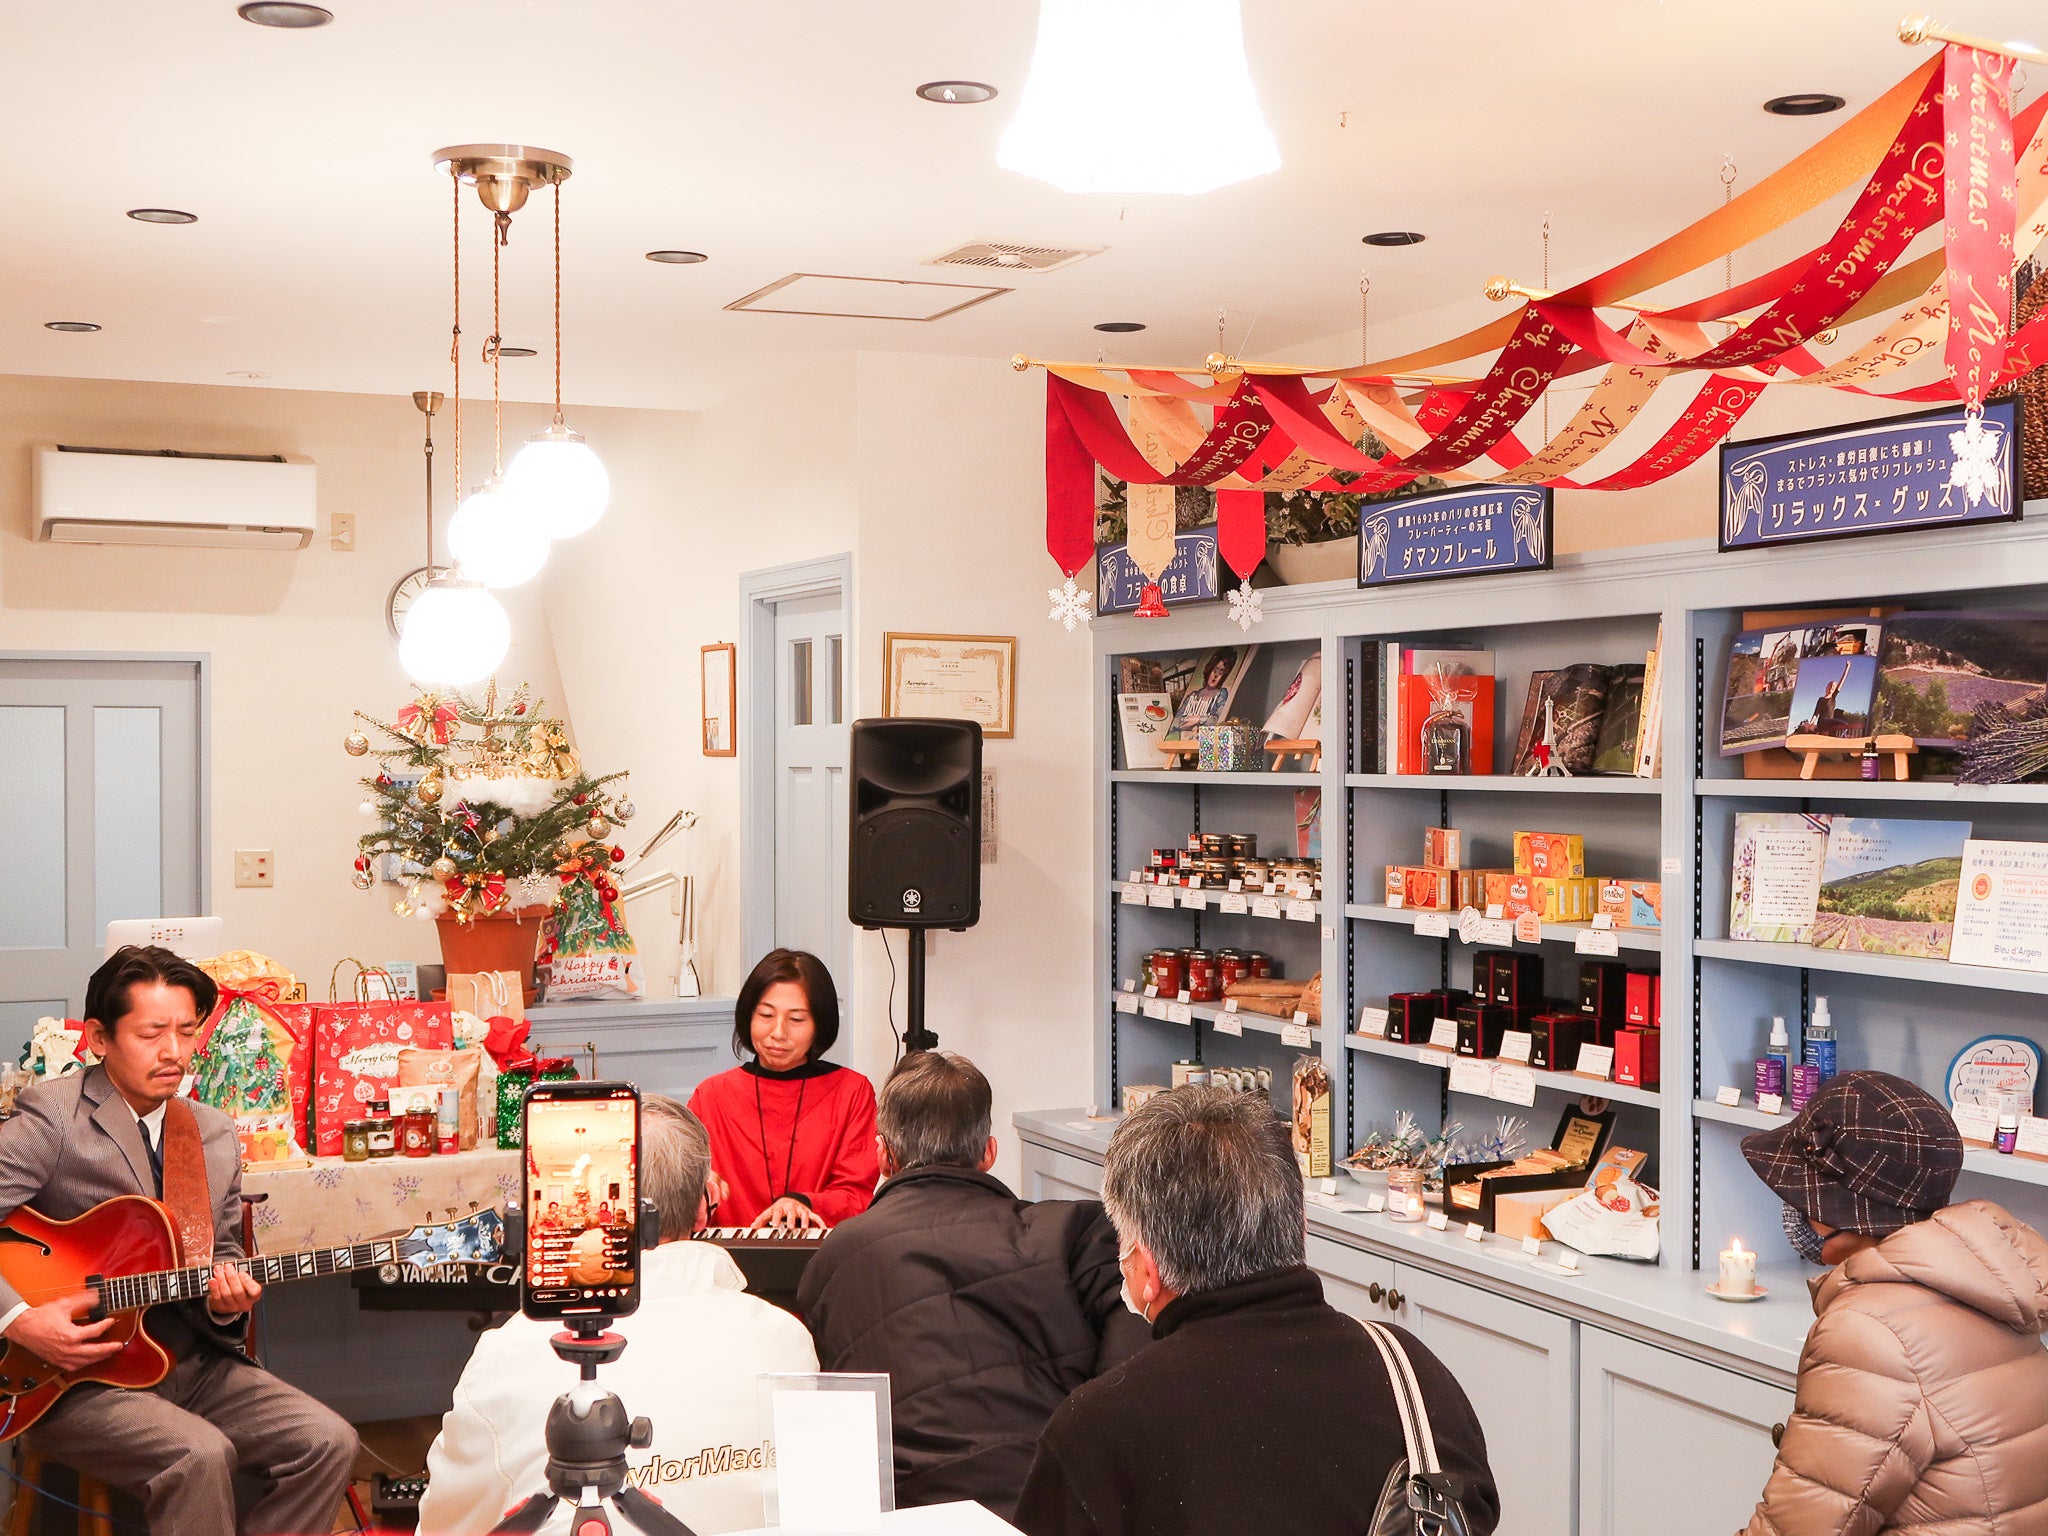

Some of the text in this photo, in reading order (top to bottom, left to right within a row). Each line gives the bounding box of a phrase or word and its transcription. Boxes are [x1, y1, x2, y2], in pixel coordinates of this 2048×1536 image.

[1826, 141, 1945, 289] Christmas
[1446, 366, 1541, 454] Christmas
[1538, 406, 1617, 465] Merry
[1649, 385, 1747, 471] Christmas
[1776, 458, 1947, 493] まるでフランス気分でリフレッシュ
[1402, 538, 1498, 570] ダマンフレール
[550, 972, 621, 987] Christmas
[564, 959, 606, 973] Happy
[401, 1264, 468, 1284] YAMAHA
